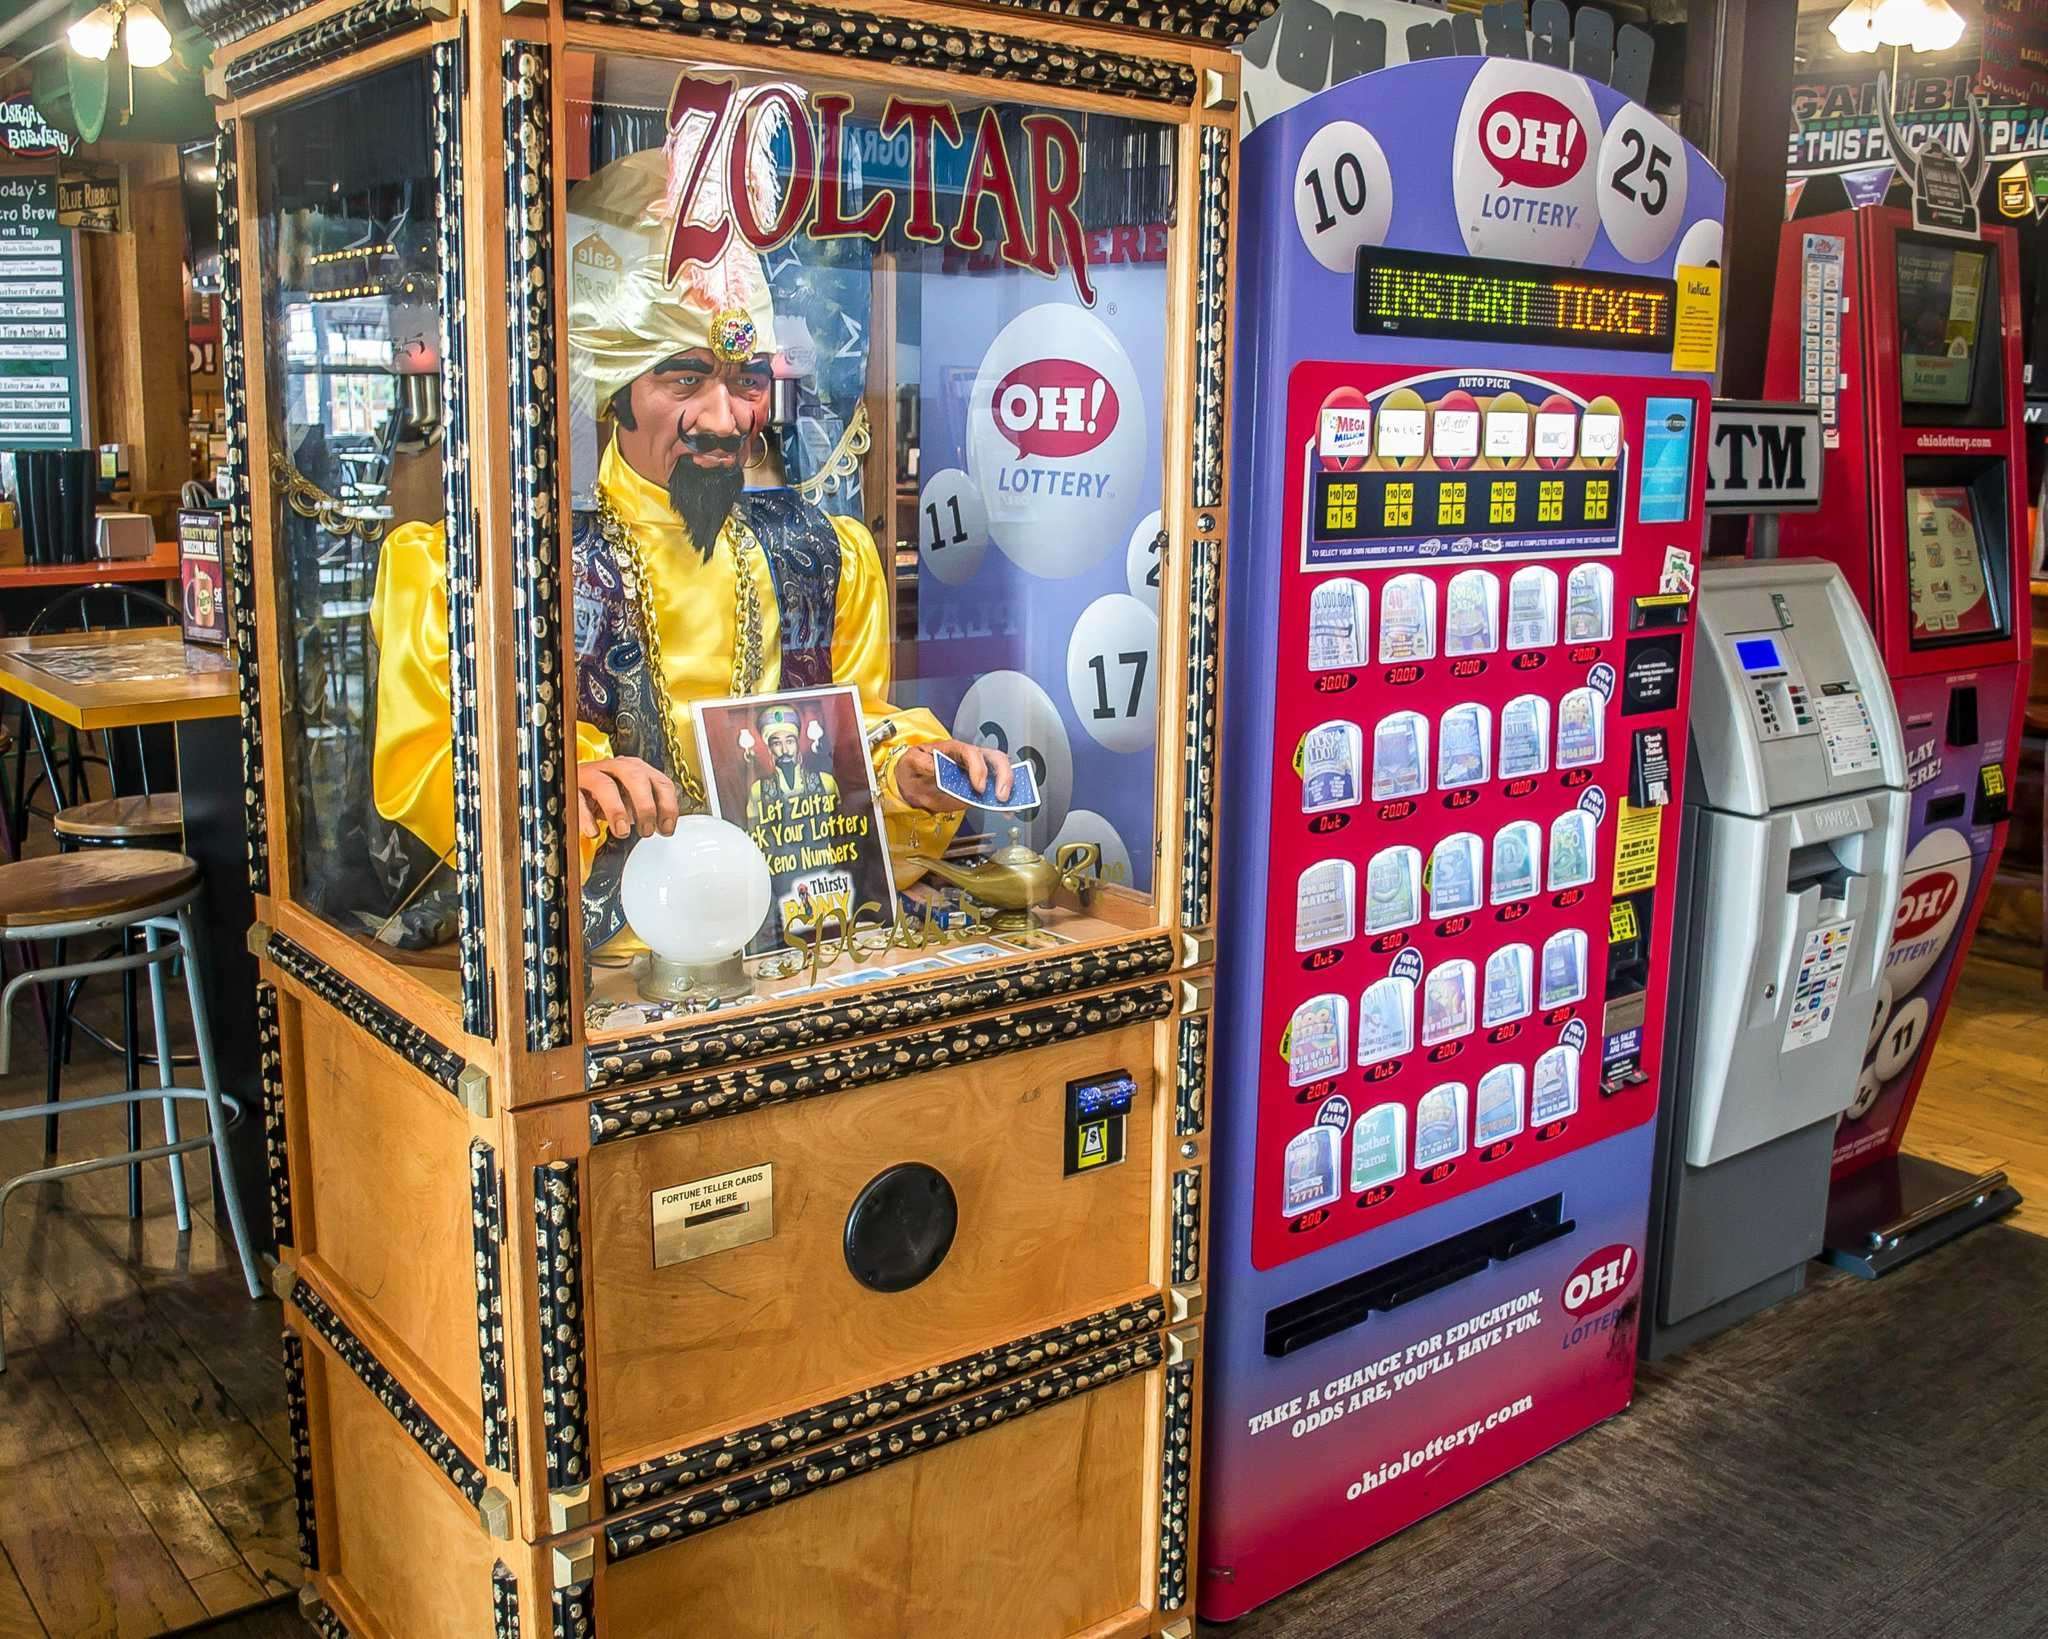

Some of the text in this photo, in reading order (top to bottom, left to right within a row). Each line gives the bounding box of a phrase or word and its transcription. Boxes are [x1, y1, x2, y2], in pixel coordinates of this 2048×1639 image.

[8, 126, 70, 155] BREWERY
[1486, 111, 1578, 169] OH!
[1804, 127, 1862, 163] THIS
[664, 67, 1098, 309] ZOLTAR
[1611, 127, 1672, 217] 25
[59, 183, 118, 211] BLUE RIBBON
[1304, 152, 1366, 234] 10
[22, 203, 56, 221] Brew
[1482, 193, 1579, 229] LOTTERY
[19, 225, 39, 239] Tap
[1376, 265, 1536, 326] INSTANT
[1553, 283, 1664, 336] TICKET
[20, 326, 46, 336] Amber
[48, 326, 62, 336] Ale
[1458, 377, 1511, 389] AUTO PICK
[1000, 377, 1106, 434] OH!
[1337, 415, 1365, 433] MEGA
[1917, 434, 1992, 451] ohiolottery.com
[998, 467, 1110, 498] LOTTERY
[1329, 490, 1341, 500] $10
[926, 494, 968, 552] 11
[1088, 650, 1148, 719] 17
[1907, 757, 1943, 790] ERE!
[757, 792, 837, 825] Let Zoltar
[771, 813, 869, 848] Your Lottery
[801, 839, 859, 872] Numbers
[809, 873, 849, 897] Thirsty
[1400, 954, 1419, 965] NEW
[1885, 940, 1938, 968] OTTERY
[1893, 1018, 1915, 1058] 11
[1326, 1102, 1346, 1114] NEW
[1359, 1120, 1379, 1136] Try
[661, 1172, 764, 1206] FORTUNE TELLER CARDS
[689, 1191, 738, 1212] TEAR HERE
[1564, 1247, 1632, 1310] OH!
[1248, 1288, 1544, 1436] TAKE A CHANCE FOR EDUCATION.
[1291, 1310, 1542, 1439] ODDS ARE, YOU'LL HAVE FUN.
[1346, 1392, 1533, 1501] ohiolottery.com
